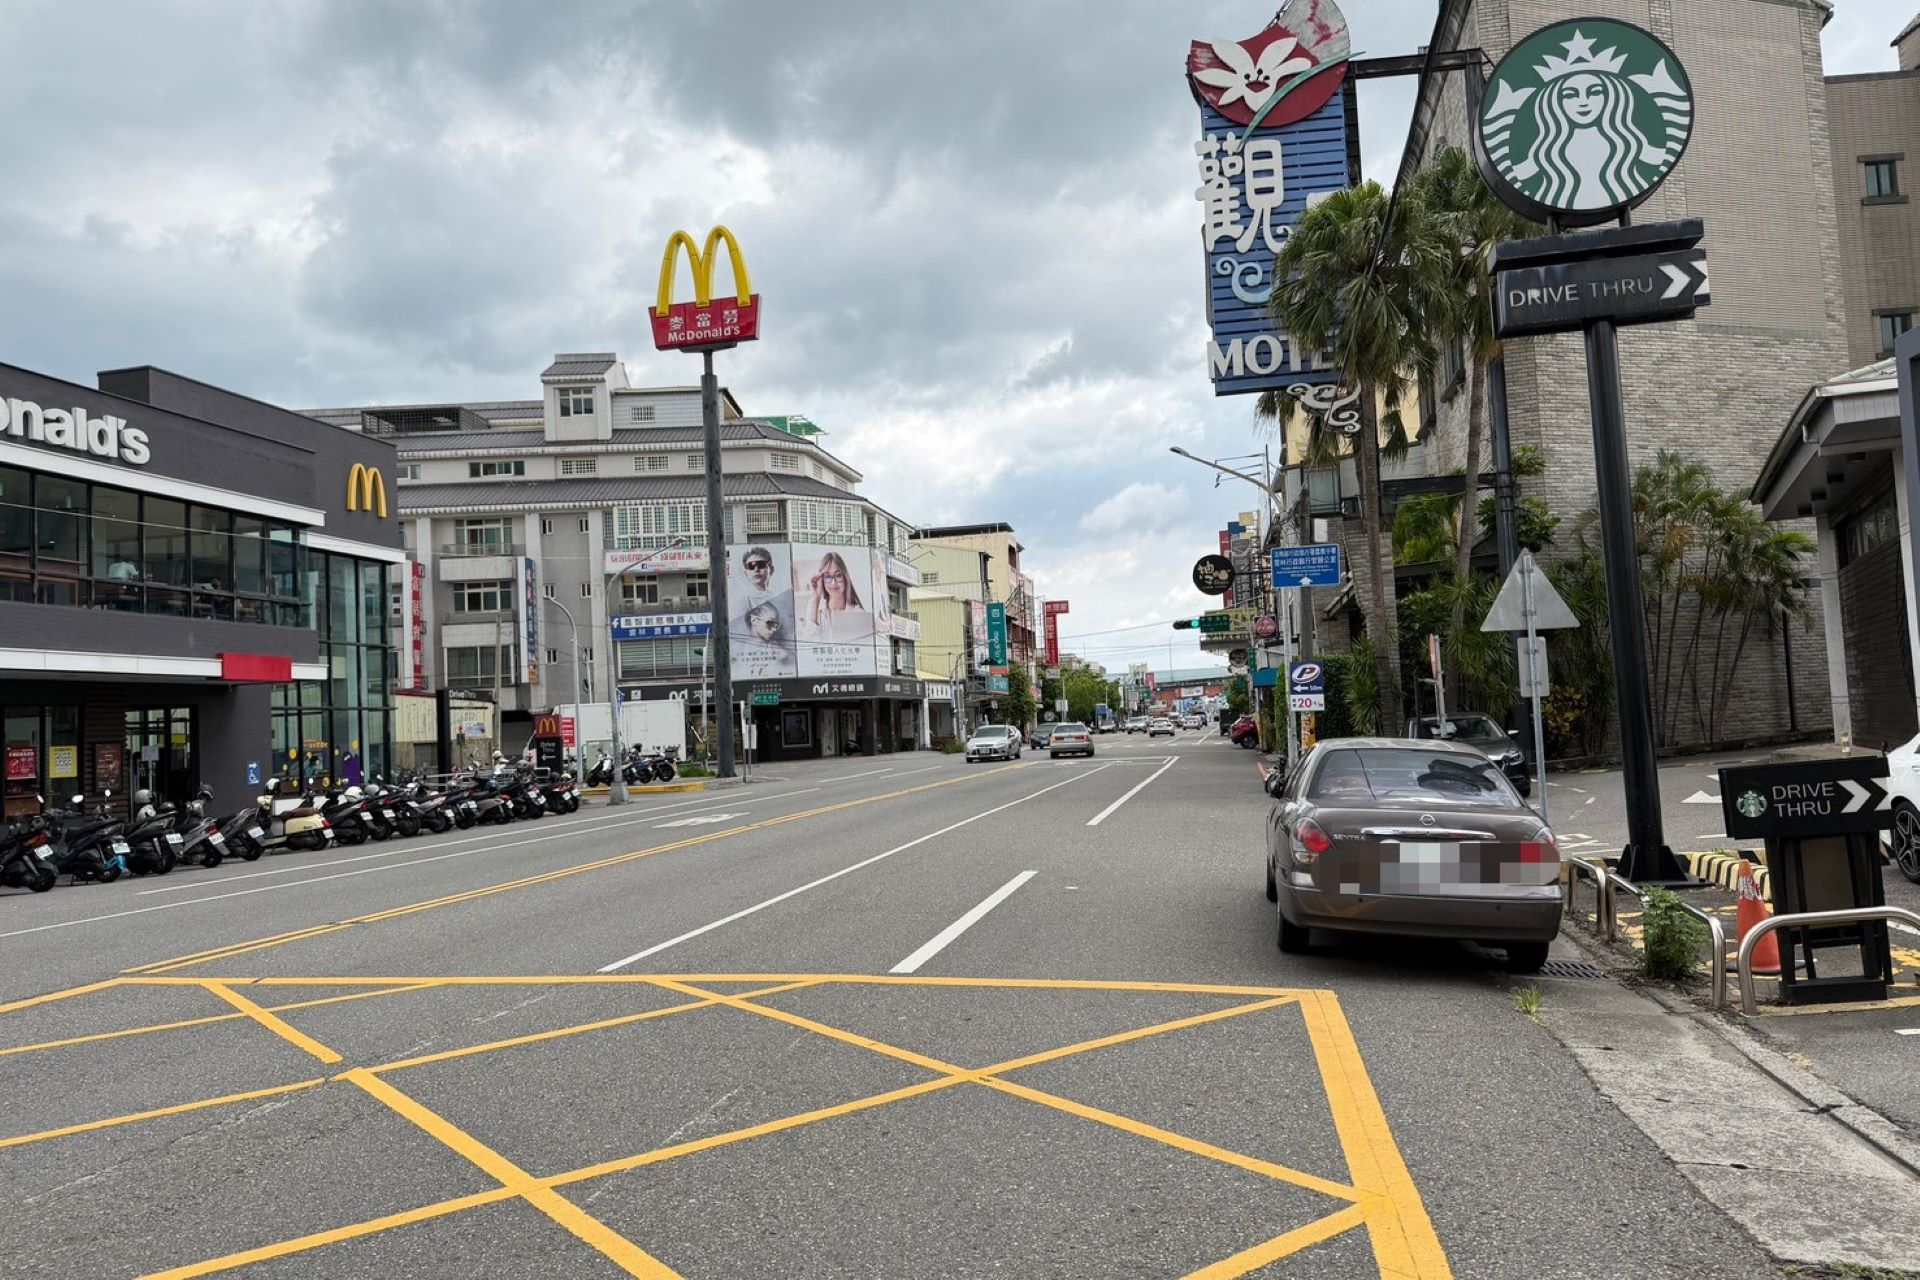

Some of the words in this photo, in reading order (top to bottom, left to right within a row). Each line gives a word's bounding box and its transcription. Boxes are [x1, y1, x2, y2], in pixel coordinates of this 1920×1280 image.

[1509, 284, 1579, 309] DRIVE
[1588, 276, 1654, 301] THRU
[667, 325, 741, 342] McDonald's
[1206, 333, 1341, 379] MOTE
[1297, 697, 1312, 709] 20
[1772, 781, 1835, 801] DRIVE
[1773, 799, 1831, 818] THRU
[1331, 833, 1366, 841] SENTRA
